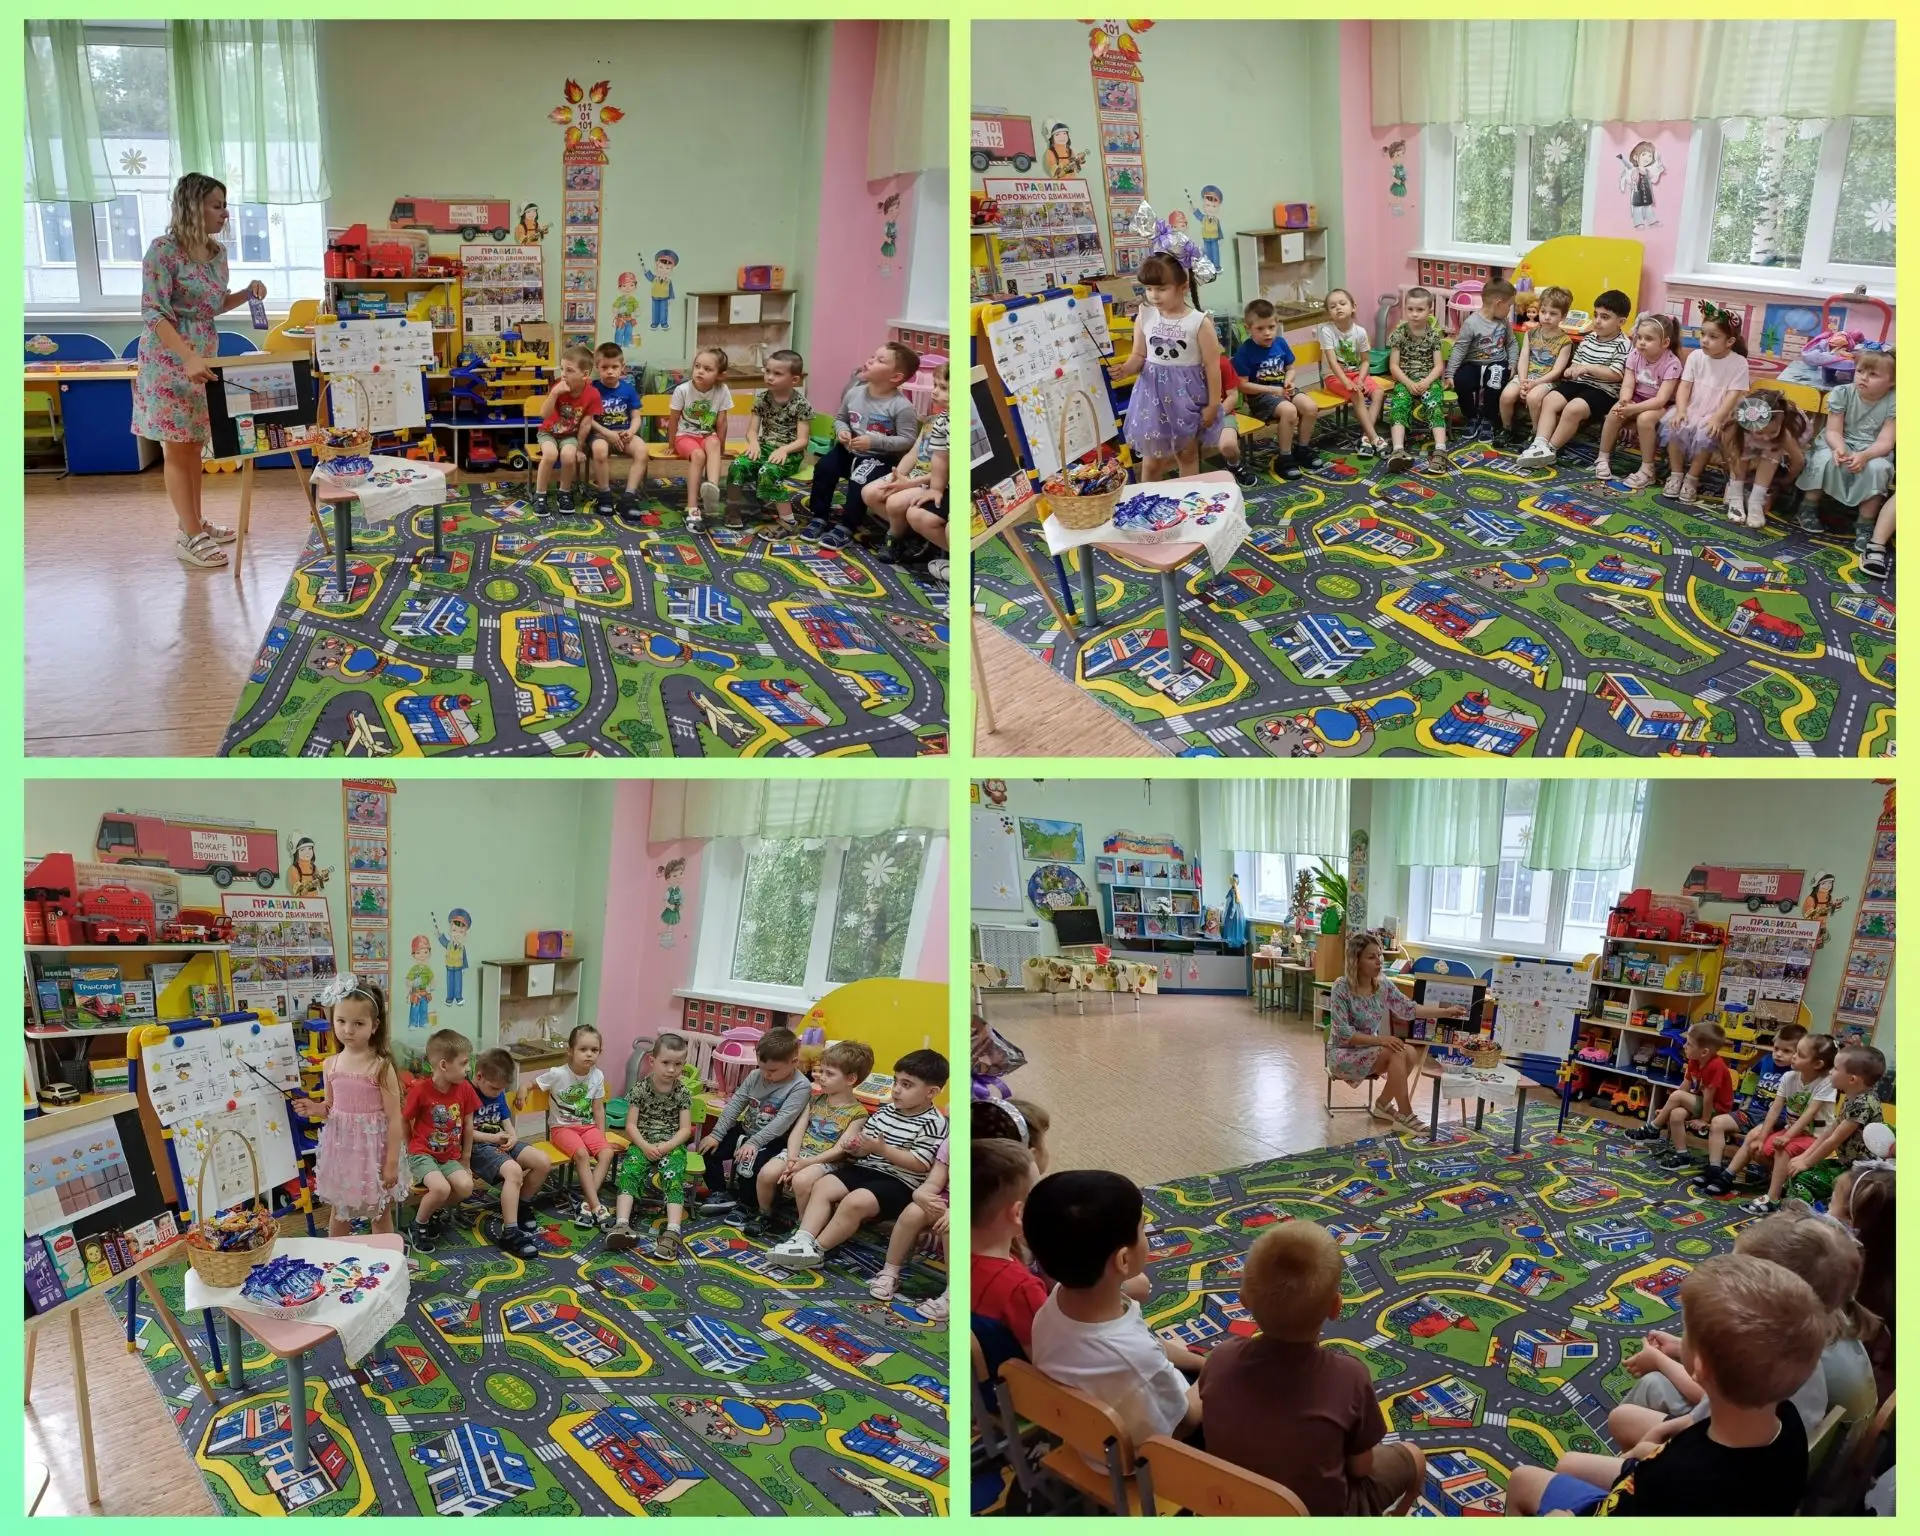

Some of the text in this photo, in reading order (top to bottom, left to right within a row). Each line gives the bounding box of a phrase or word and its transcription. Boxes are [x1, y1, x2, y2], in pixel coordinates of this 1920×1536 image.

[1104, 23, 1120, 35] 101
[578, 103, 592, 111] 112
[580, 112, 590, 120] 01
[579, 121, 592, 129] 101
[985, 122, 1001, 133] 101
[988, 136, 1003, 146] 112
[1014, 182, 1068, 192] ПРАВИЛА
[995, 192, 1086, 202] ДОРОЖНОГО ДВИЖЕНИЯ
[476, 206, 488, 214] 101
[1197, 653, 1211, 667] H
[1497, 659, 1531, 678] BUS
[839, 676, 868, 697] BUS
[518, 691, 534, 713] BUS
[1484, 718, 1522, 734] AIRPORT
[201, 832, 218, 841] ПРИ
[230, 835, 246, 847] 101
[193, 841, 228, 851] ПОЖАРЕ
[193, 851, 229, 861] ЗВОНИТЬ
[231, 850, 248, 862] 112
[1767, 875, 1779, 884] 101
[1765, 885, 1777, 894] 112
[252, 899, 306, 910] ПРАВИЛА
[231, 910, 324, 919] ДОРОЖНОГО ДВИЖЕНИЯ
[1749, 918, 1798, 929] ПРАВИЛА
[1733, 924, 1814, 937] ДОРОЖНОГО ДВИЖЕНИЯ
[1762, 1072, 1782, 1081] OF
[105, 1242, 121, 1273] SNICKERS
[117, 1237, 133, 1267] SNICKERS
[504, 1375, 532, 1398] BEST
[488, 1378, 527, 1409] CARPET
[902, 1391, 942, 1413] BUS
[475, 1431, 498, 1445] P
[898, 1442, 941, 1462] AIRPORT
[325, 1450, 342, 1469] H
[456, 1466, 470, 1499] POLICE
